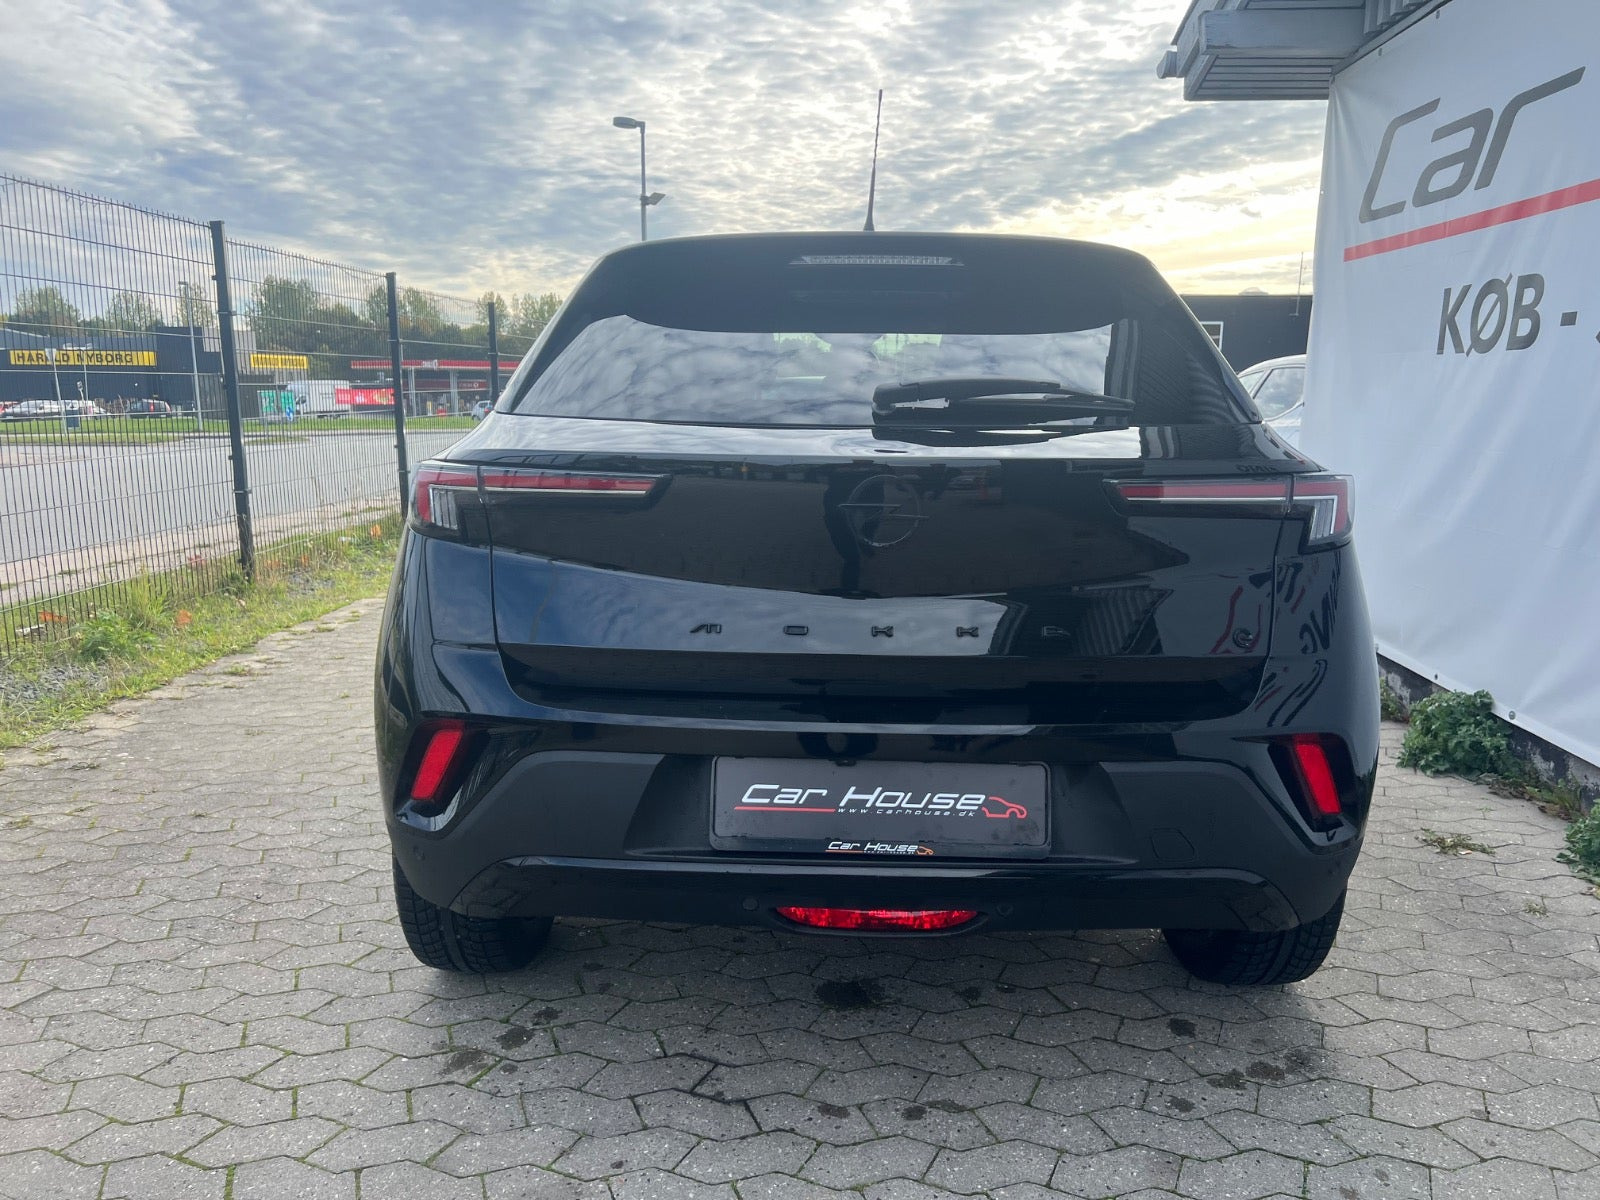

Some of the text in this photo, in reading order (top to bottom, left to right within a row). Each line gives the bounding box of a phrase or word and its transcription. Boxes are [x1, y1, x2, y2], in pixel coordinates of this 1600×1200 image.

[1359, 66, 1586, 224] Car
[1436, 273, 1545, 357] KØB
[16, 352, 133, 364] HARLD NYBORG
[741, 783, 986, 810] Car House
[837, 808, 976, 817] www.carhouse.dk
[828, 841, 919, 852] Car House
